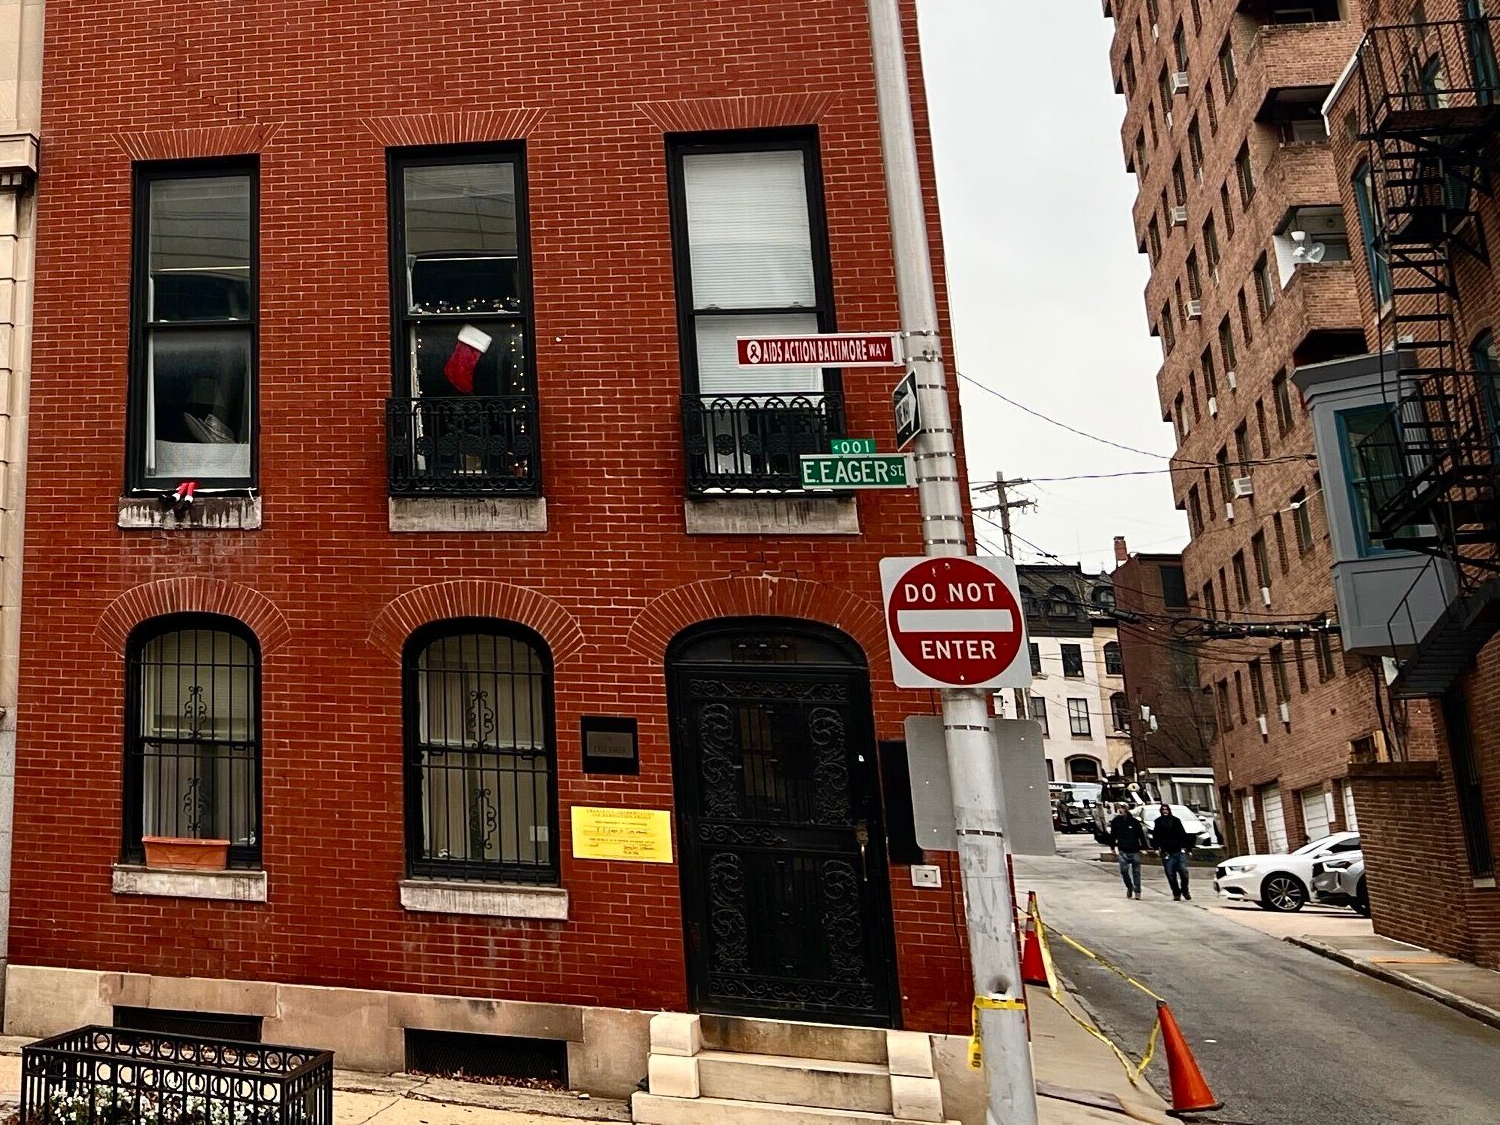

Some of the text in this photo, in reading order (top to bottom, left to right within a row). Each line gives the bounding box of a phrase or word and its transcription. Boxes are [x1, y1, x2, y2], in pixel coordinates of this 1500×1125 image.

[763, 339, 887, 363] AIDS ACTION BALTIMORE WAY
[841, 440, 870, 454] 001
[904, 582, 996, 603] DO NOT
[920, 640, 997, 660] ENTER
